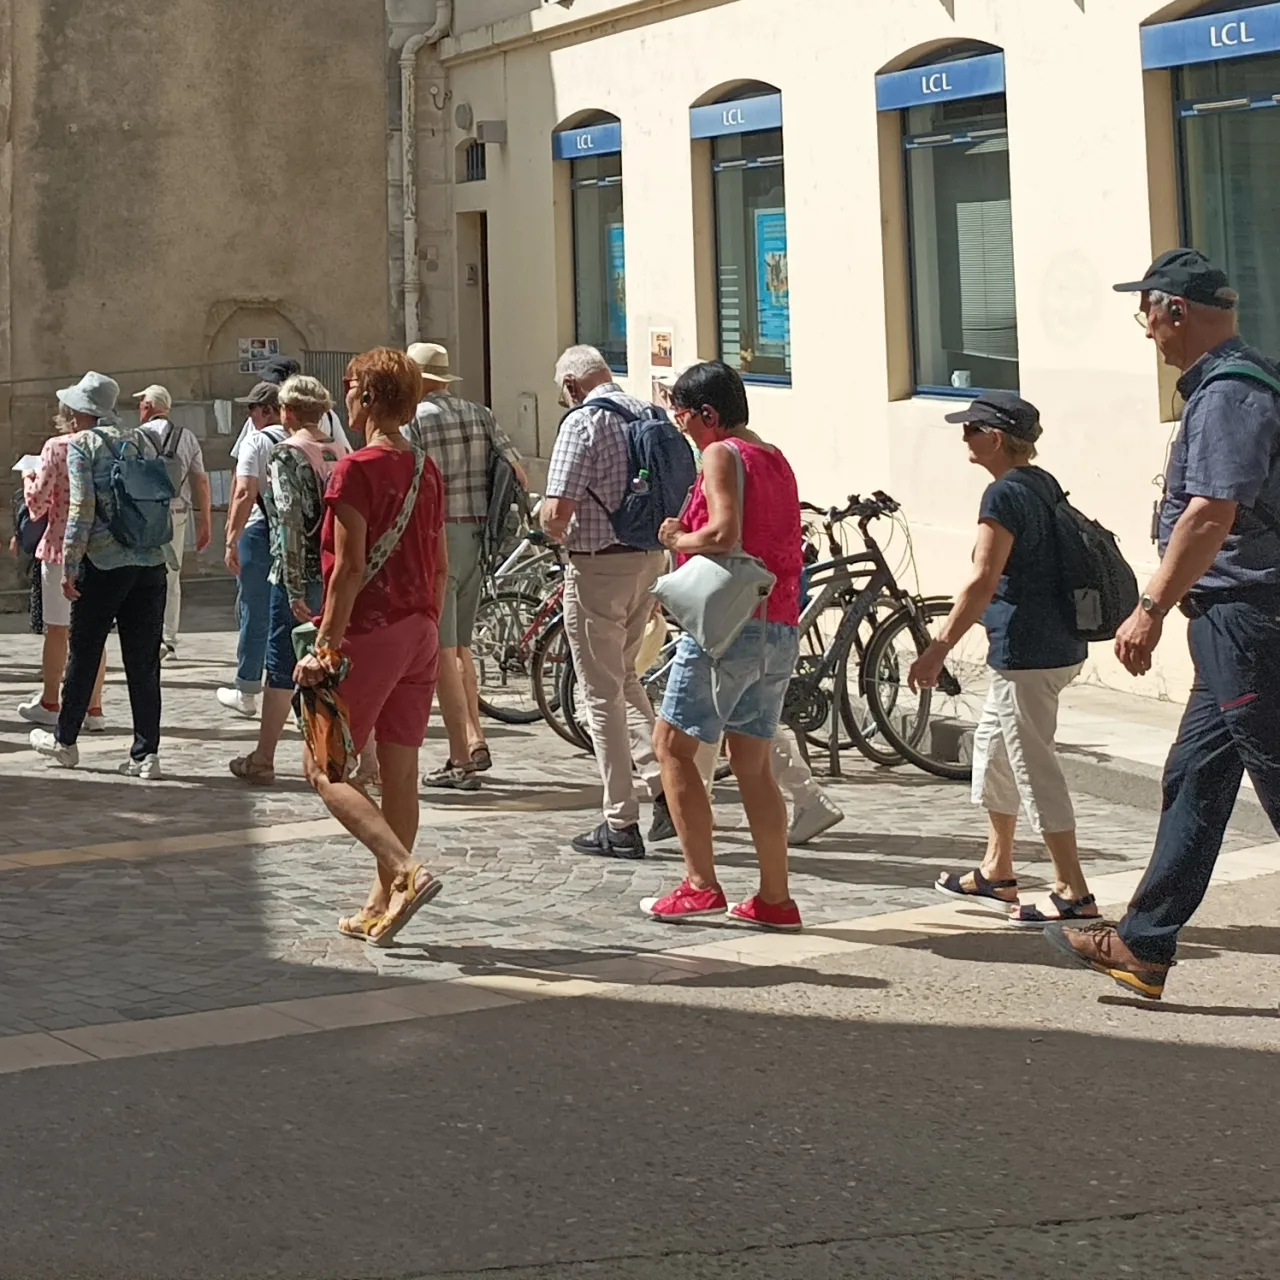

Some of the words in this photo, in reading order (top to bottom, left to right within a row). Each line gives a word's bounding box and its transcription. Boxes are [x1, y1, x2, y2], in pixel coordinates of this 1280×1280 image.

[1209, 22, 1256, 48] LCL
[921, 73, 952, 95] LCL
[722, 107, 746, 126] LCL
[575, 133, 594, 149] LCL
